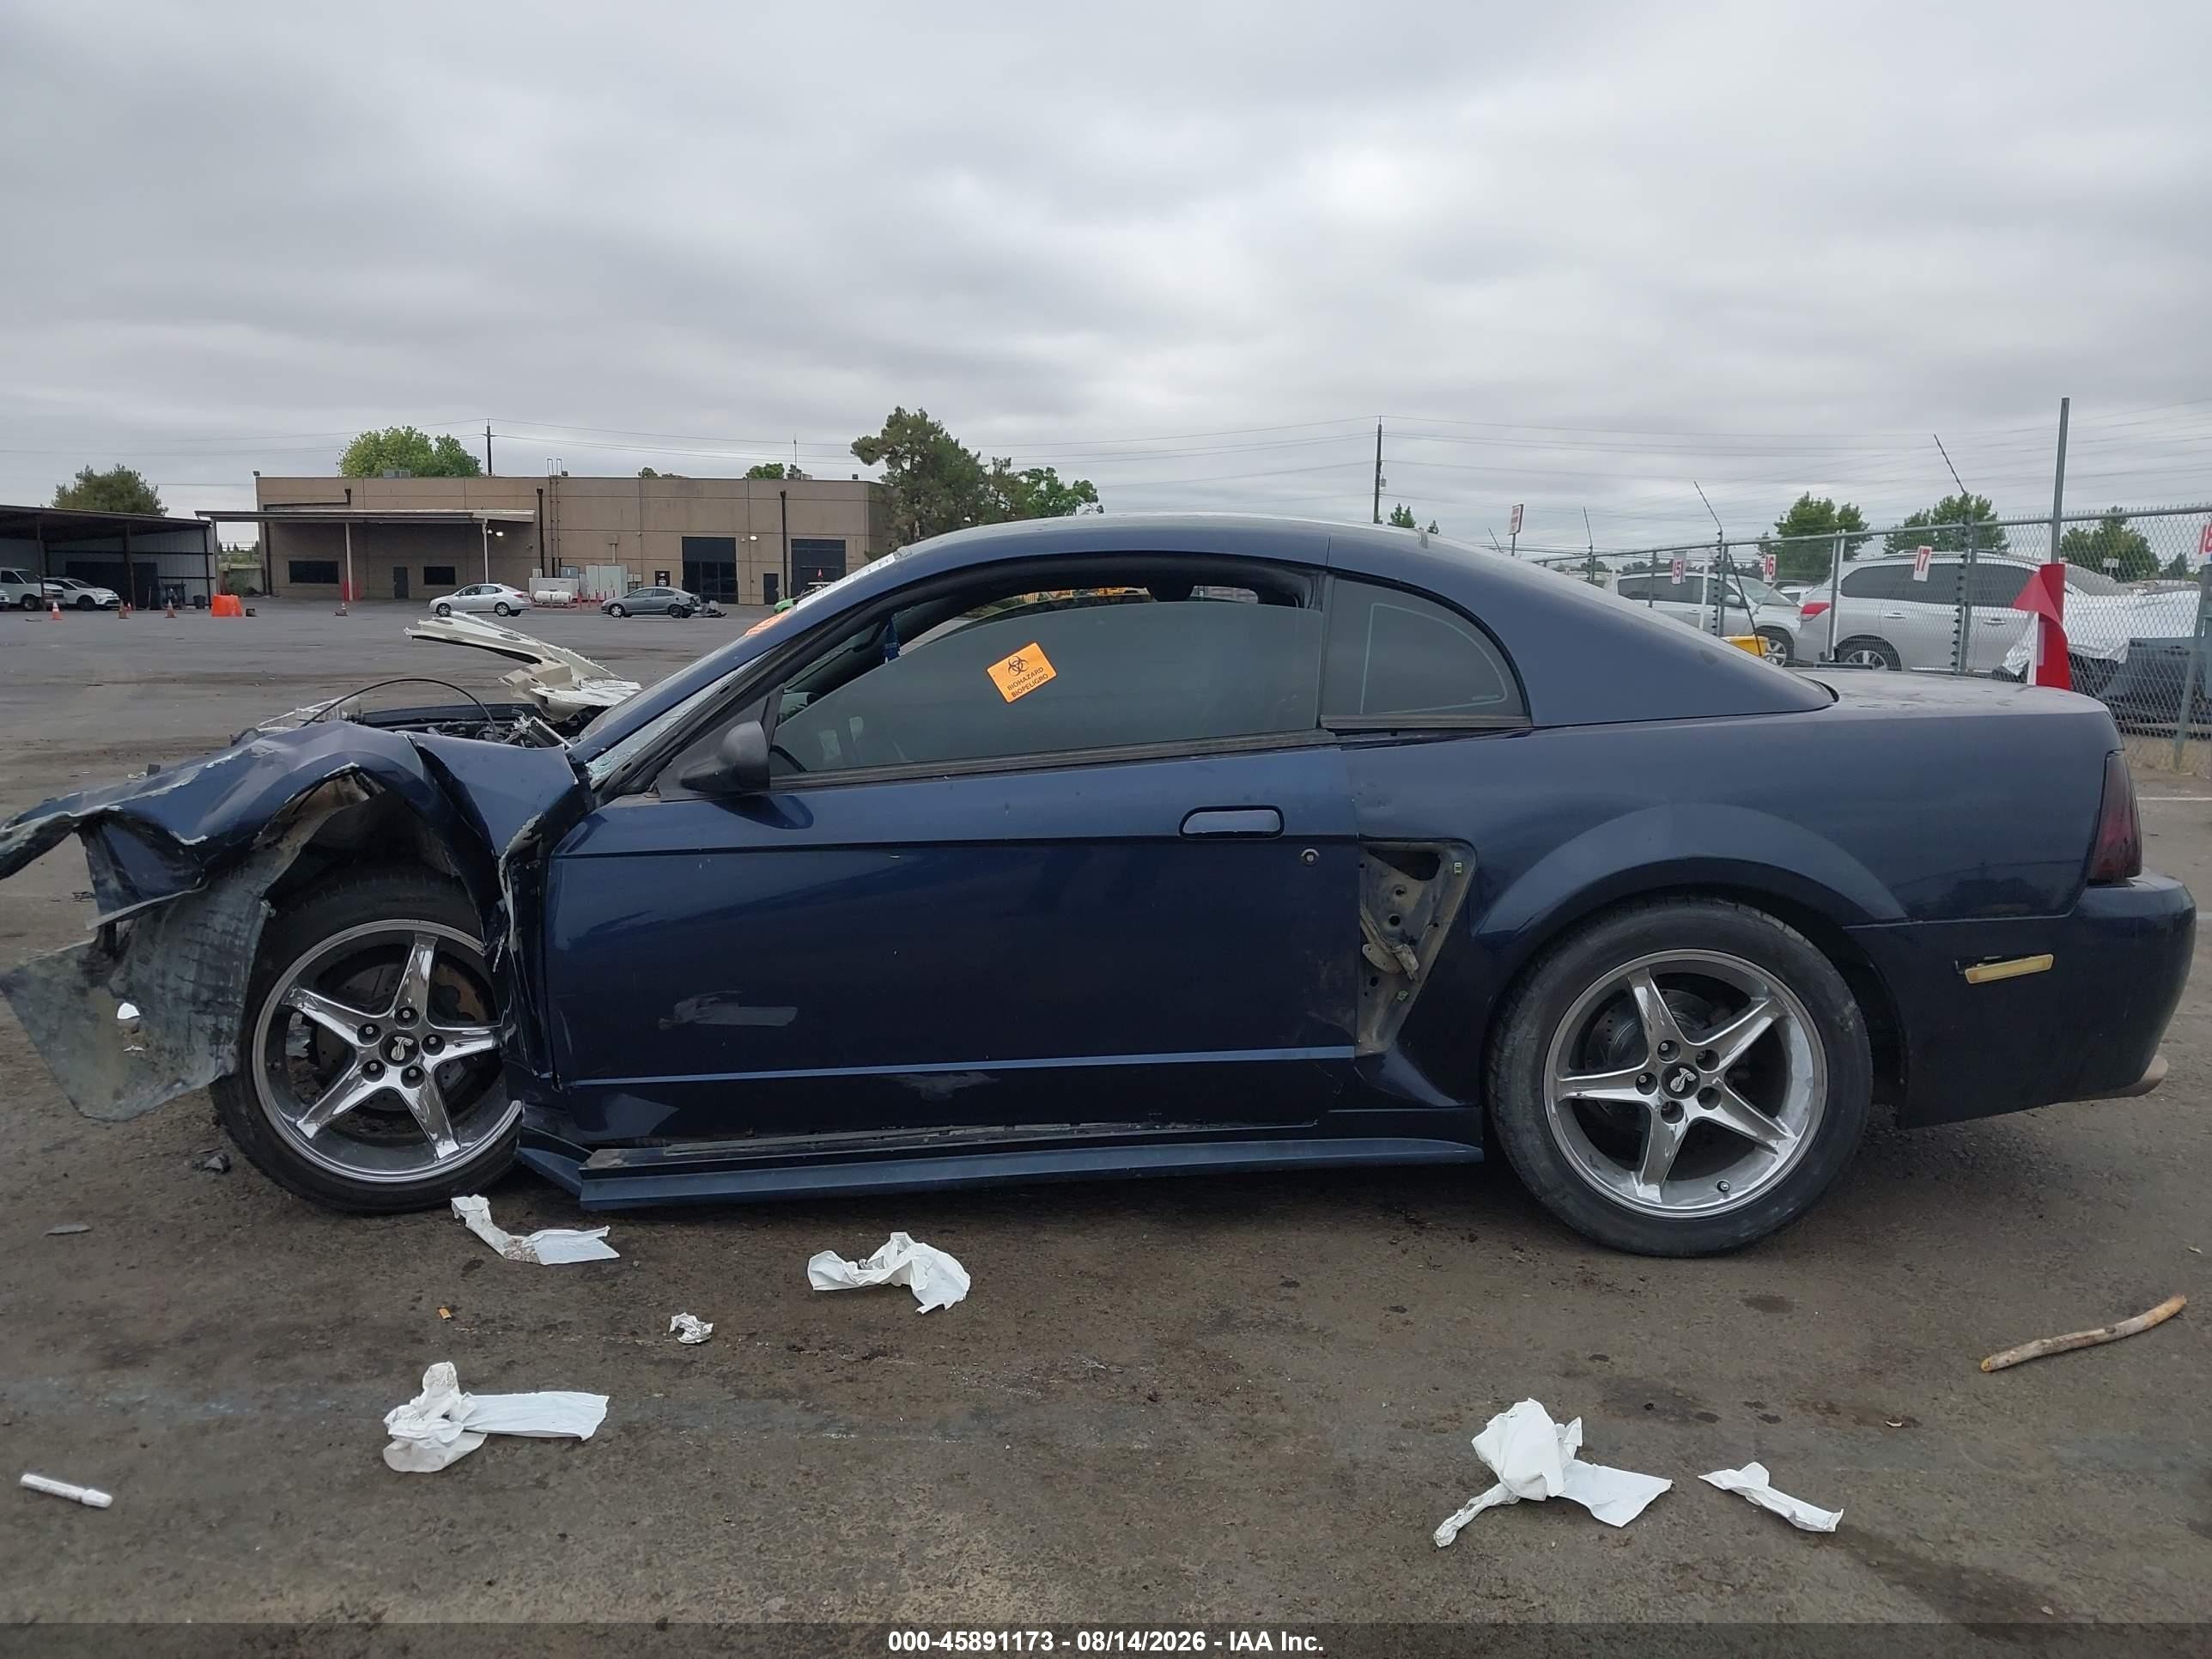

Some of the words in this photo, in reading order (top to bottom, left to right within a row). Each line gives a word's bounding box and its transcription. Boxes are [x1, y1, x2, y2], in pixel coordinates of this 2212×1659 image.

[1673, 561, 1681, 578] 15
[1765, 556, 1775, 575] 16
[1916, 549, 1930, 572] 17
[1006, 666, 1044, 691] BIOHAZARD
[1011, 673, 1048, 698] BIOPELIGRO
